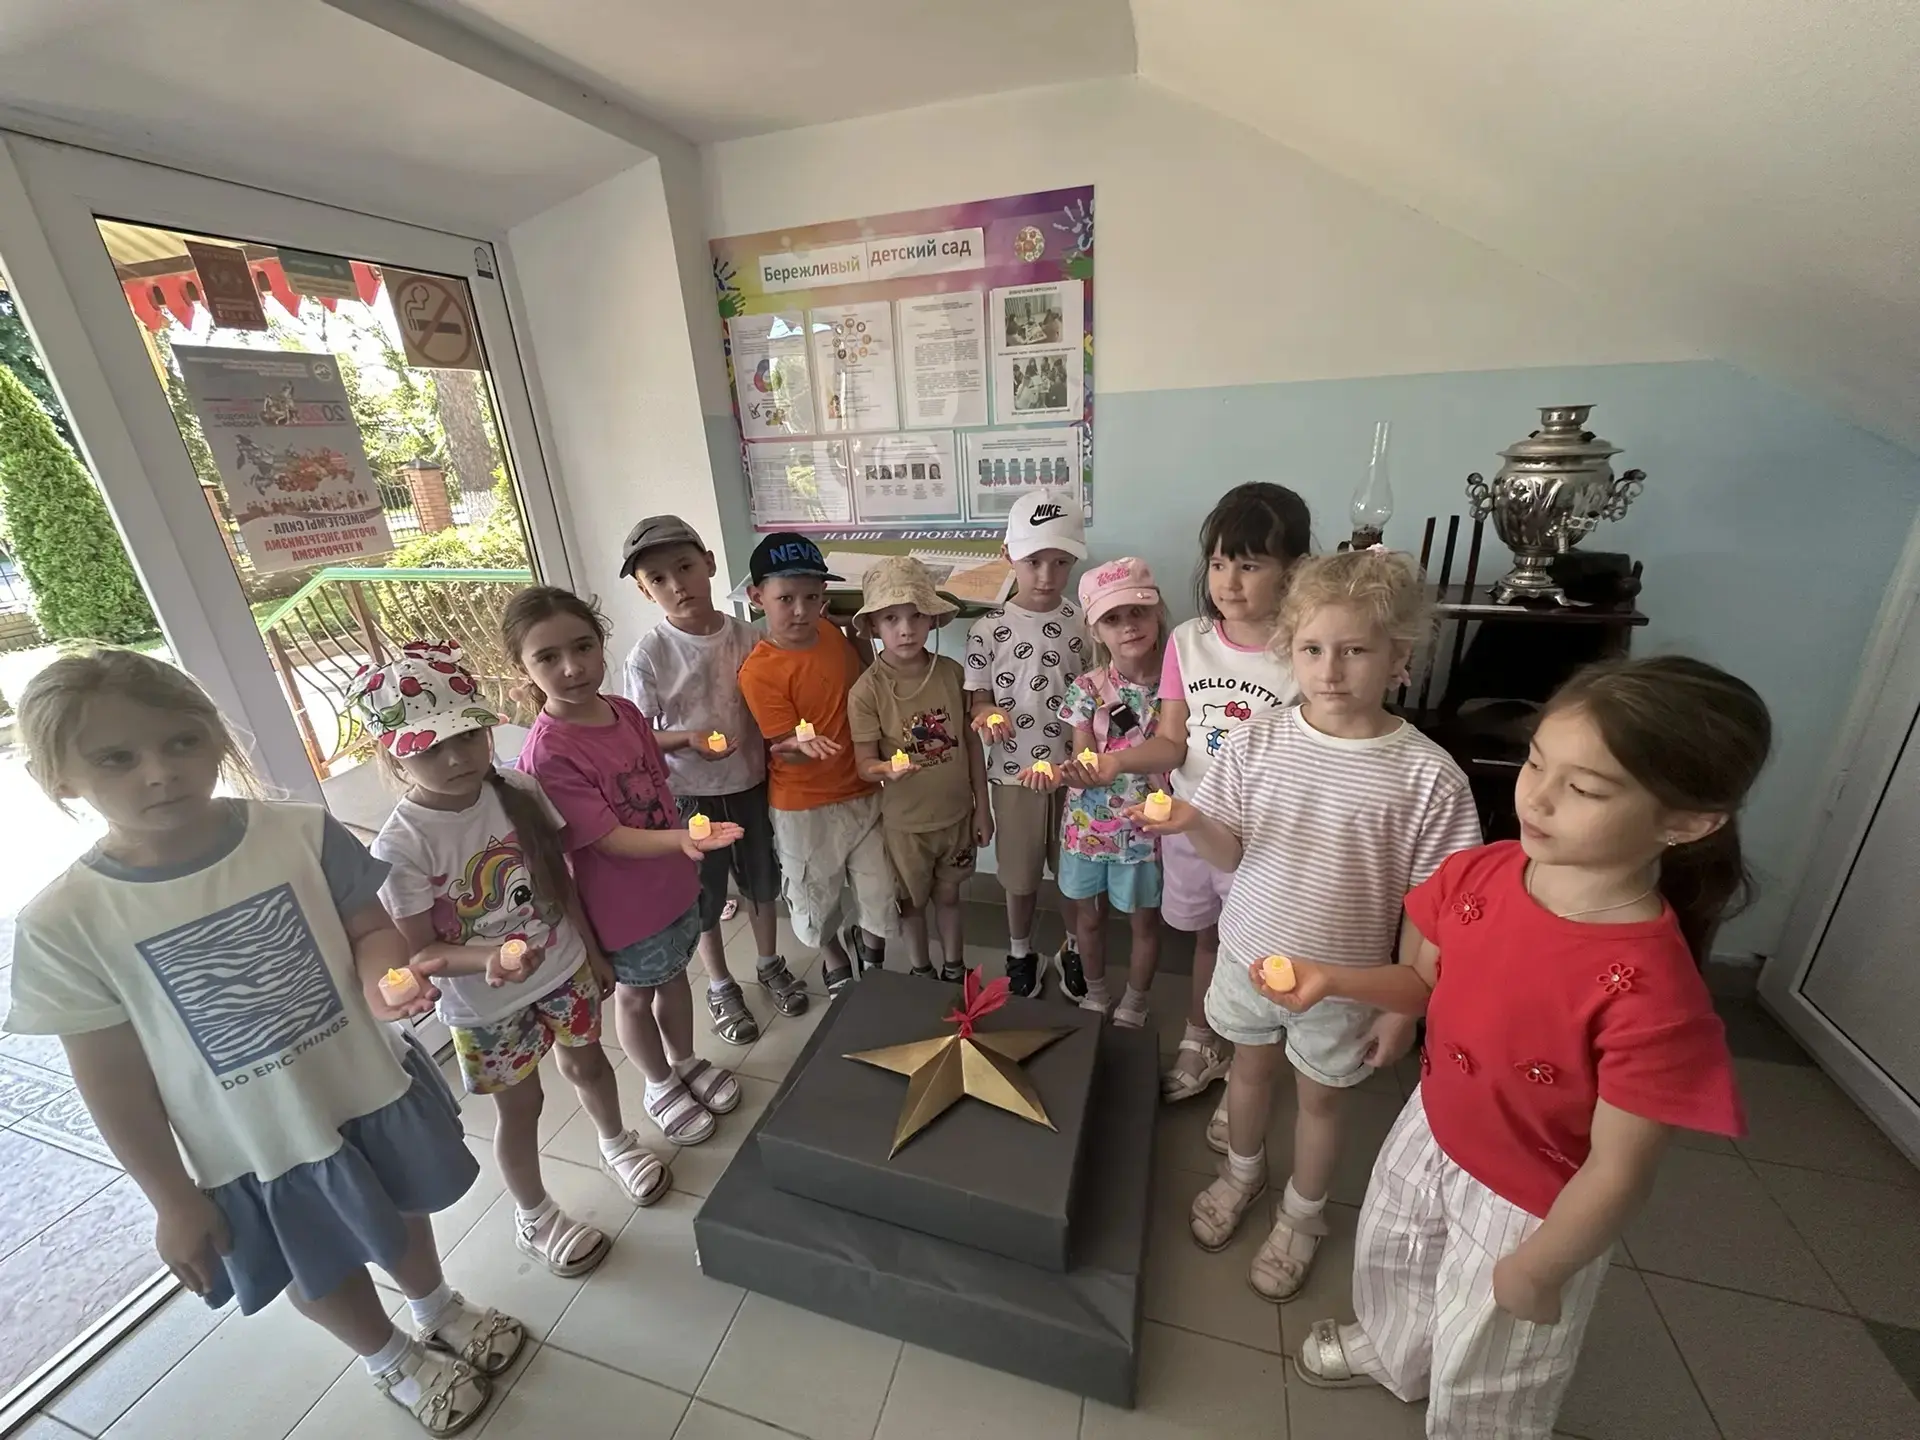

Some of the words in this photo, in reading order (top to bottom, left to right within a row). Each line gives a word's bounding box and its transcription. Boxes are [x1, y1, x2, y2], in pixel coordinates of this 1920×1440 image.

[764, 256, 860, 284] Бережливый
[870, 240, 937, 267] детский
[941, 239, 972, 257] сад
[1034, 504, 1061, 517] NIKE
[823, 531, 884, 541] НАШИ
[900, 530, 1000, 540] ПРОЕКТЫ
[1188, 677, 1237, 694] HELLO
[1240, 681, 1282, 708] KITTY
[220, 1074, 250, 1091] DO
[252, 1054, 295, 1078] EPIC
[295, 1016, 349, 1056] THINGS
